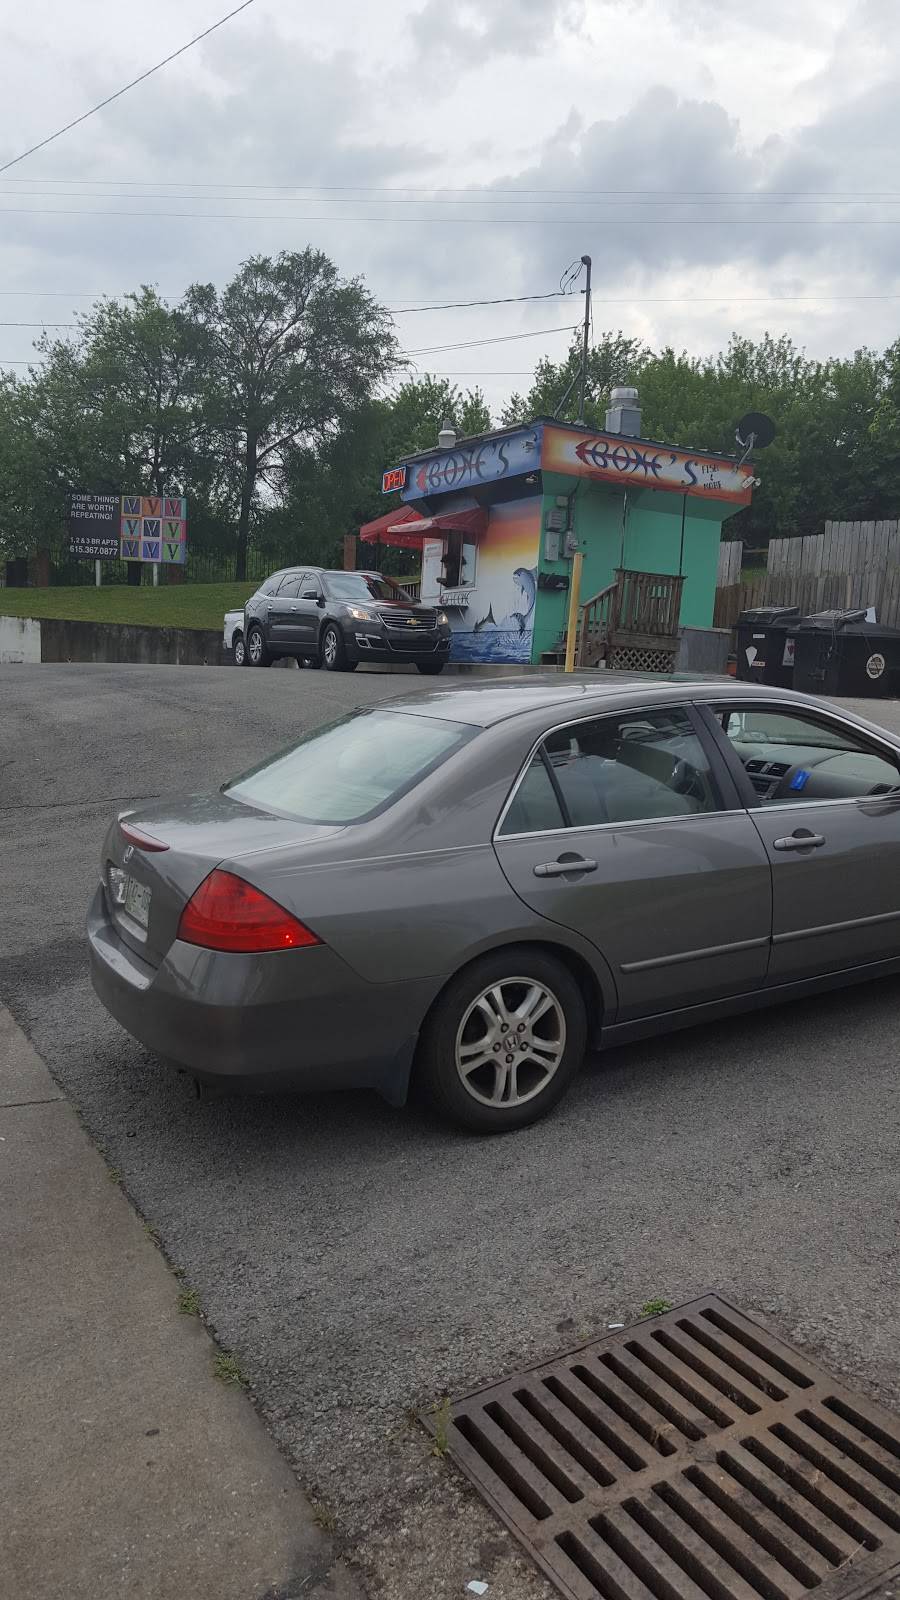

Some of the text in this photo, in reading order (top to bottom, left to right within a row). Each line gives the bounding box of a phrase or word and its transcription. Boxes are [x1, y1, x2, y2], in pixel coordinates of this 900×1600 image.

[429, 440, 511, 488] BONE'S
[591, 441, 699, 487] BONE'S
[383, 469, 406, 492] OPEN
[71, 494, 120, 504] SOME THINGS
[70, 511, 113, 520] REPEATING!
[87, 503, 114, 512] WORTH
